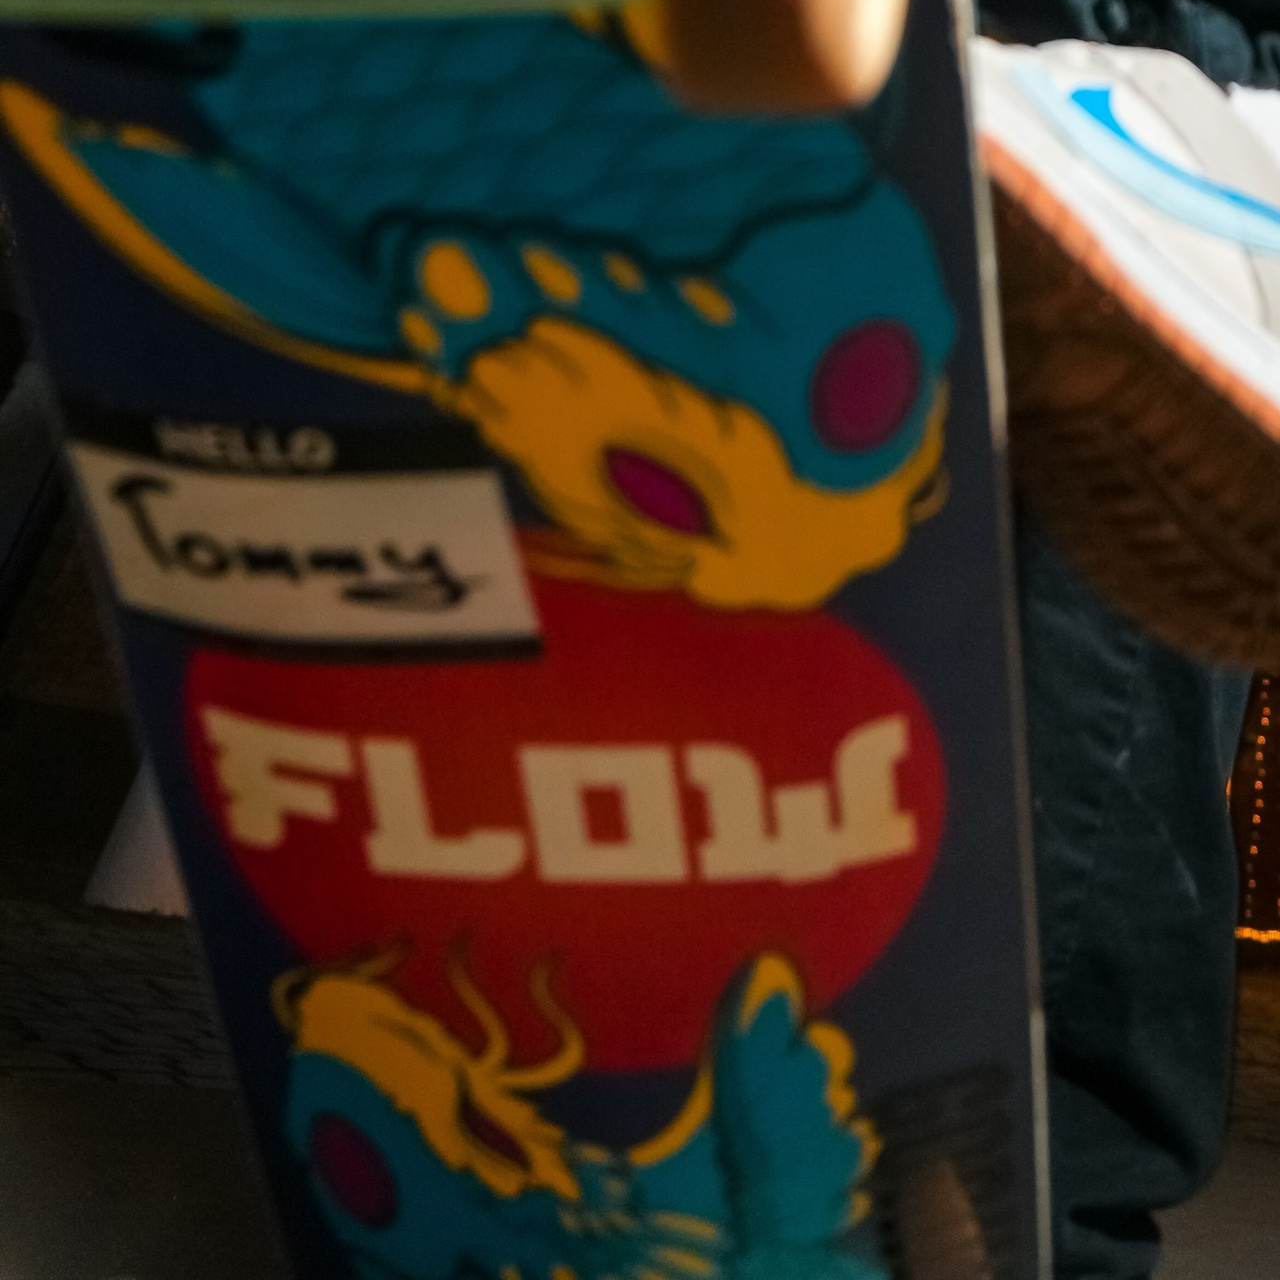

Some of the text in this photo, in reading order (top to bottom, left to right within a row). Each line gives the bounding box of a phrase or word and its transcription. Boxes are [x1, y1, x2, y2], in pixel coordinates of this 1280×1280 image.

[151, 417, 338, 471] HELLO
[112, 474, 478, 612] Tommy
[200, 704, 918, 885] FLOW
